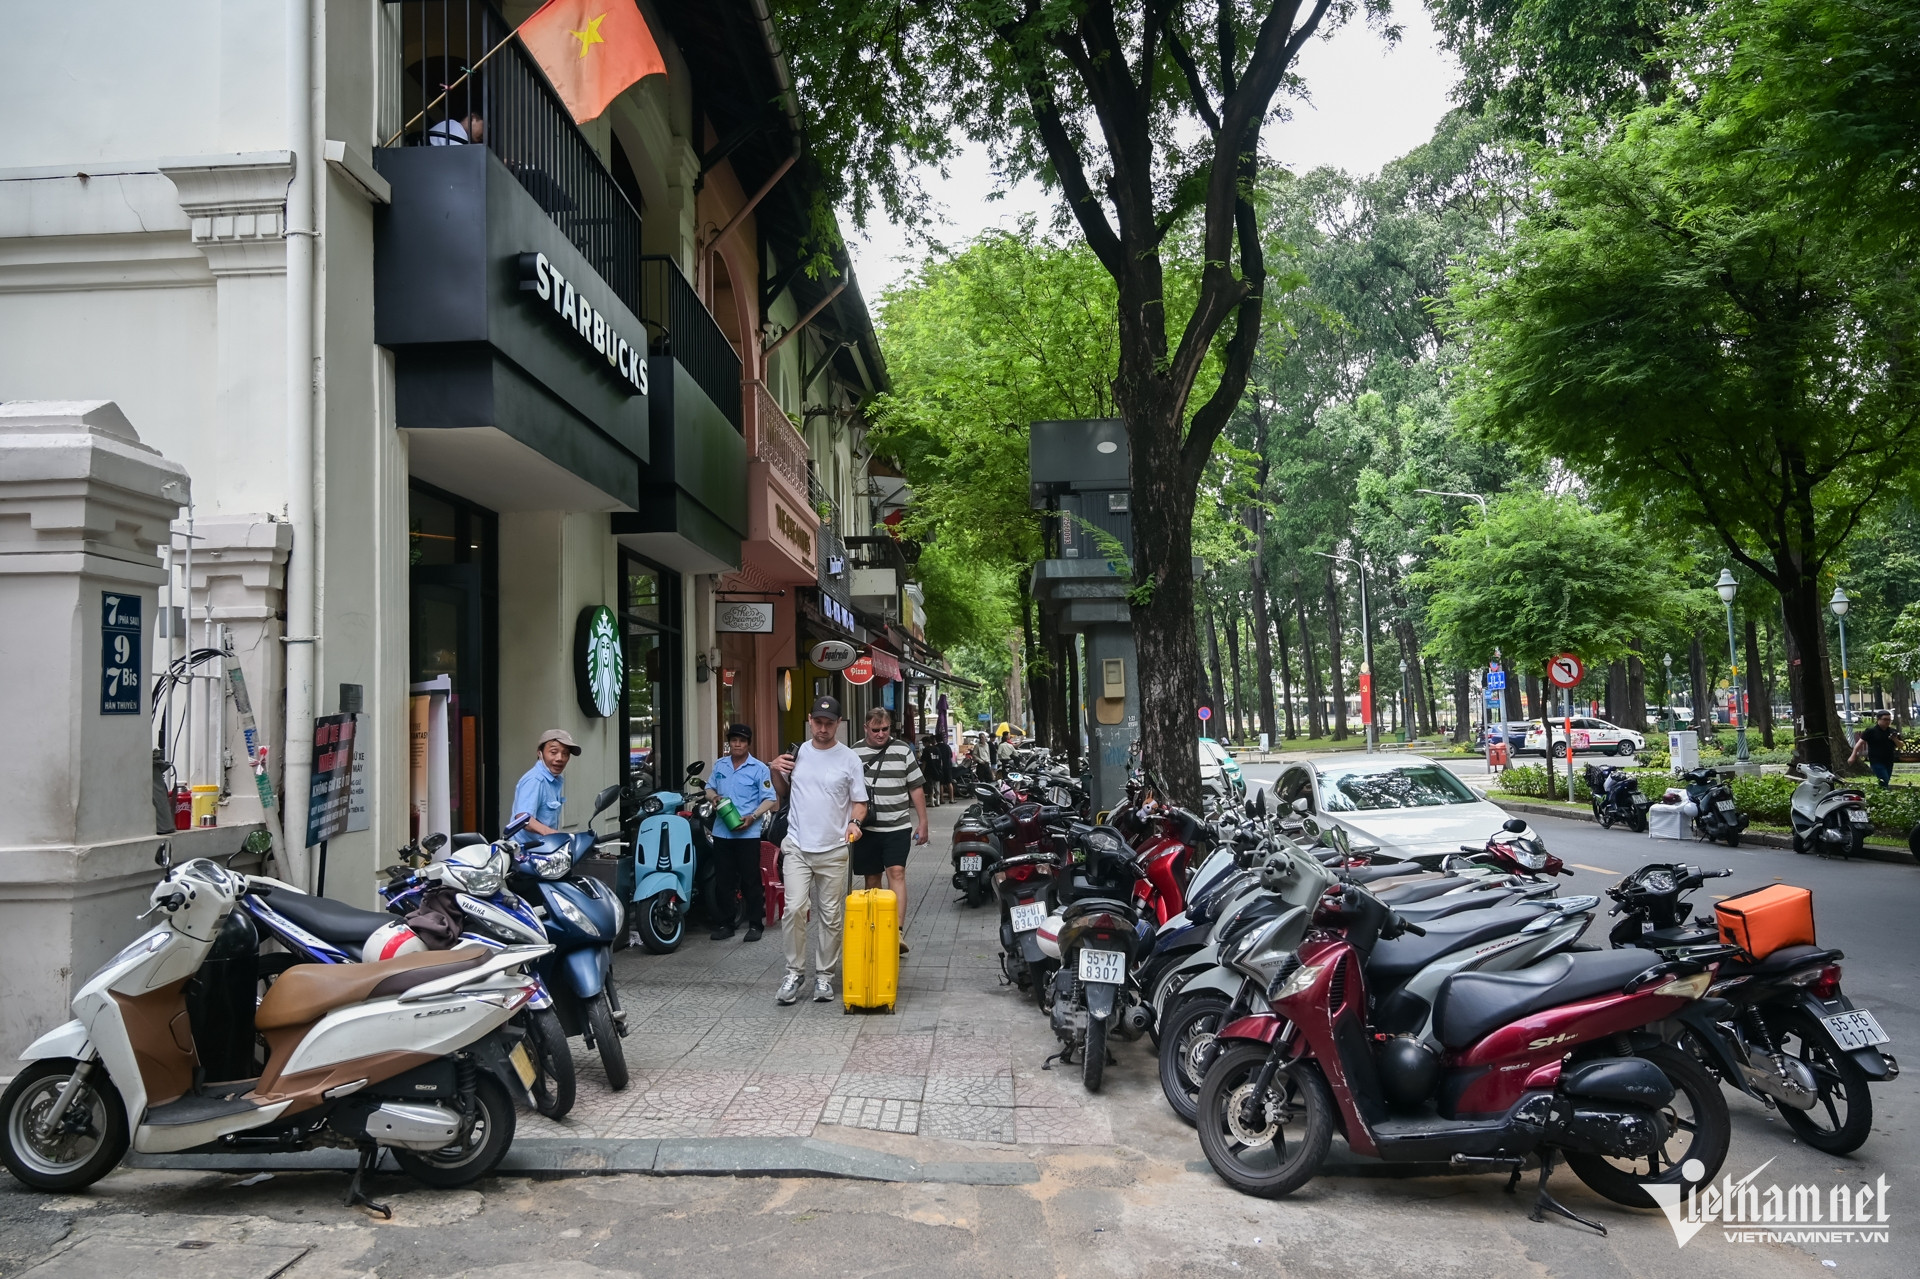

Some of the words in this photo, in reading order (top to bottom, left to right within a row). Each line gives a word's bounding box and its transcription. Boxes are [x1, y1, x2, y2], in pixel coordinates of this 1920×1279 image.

[536, 252, 648, 396] STARBUCKS
[105, 595, 121, 626] 7
[114, 634, 130, 664] 9
[850, 667, 868, 676] Pizza
[106, 667, 122, 697] 7
[122, 668, 138, 686] Bis
[461, 901, 486, 916] YAMAHA
[1086, 952, 1118, 967] 55-X7
[1086, 966, 1118, 981] 8307
[413, 1005, 467, 1018] LEAD
[1829, 1013, 1869, 1032] 55-P6
[1527, 1033, 1566, 1050] SH
[1841, 1028, 1880, 1047] 4171
